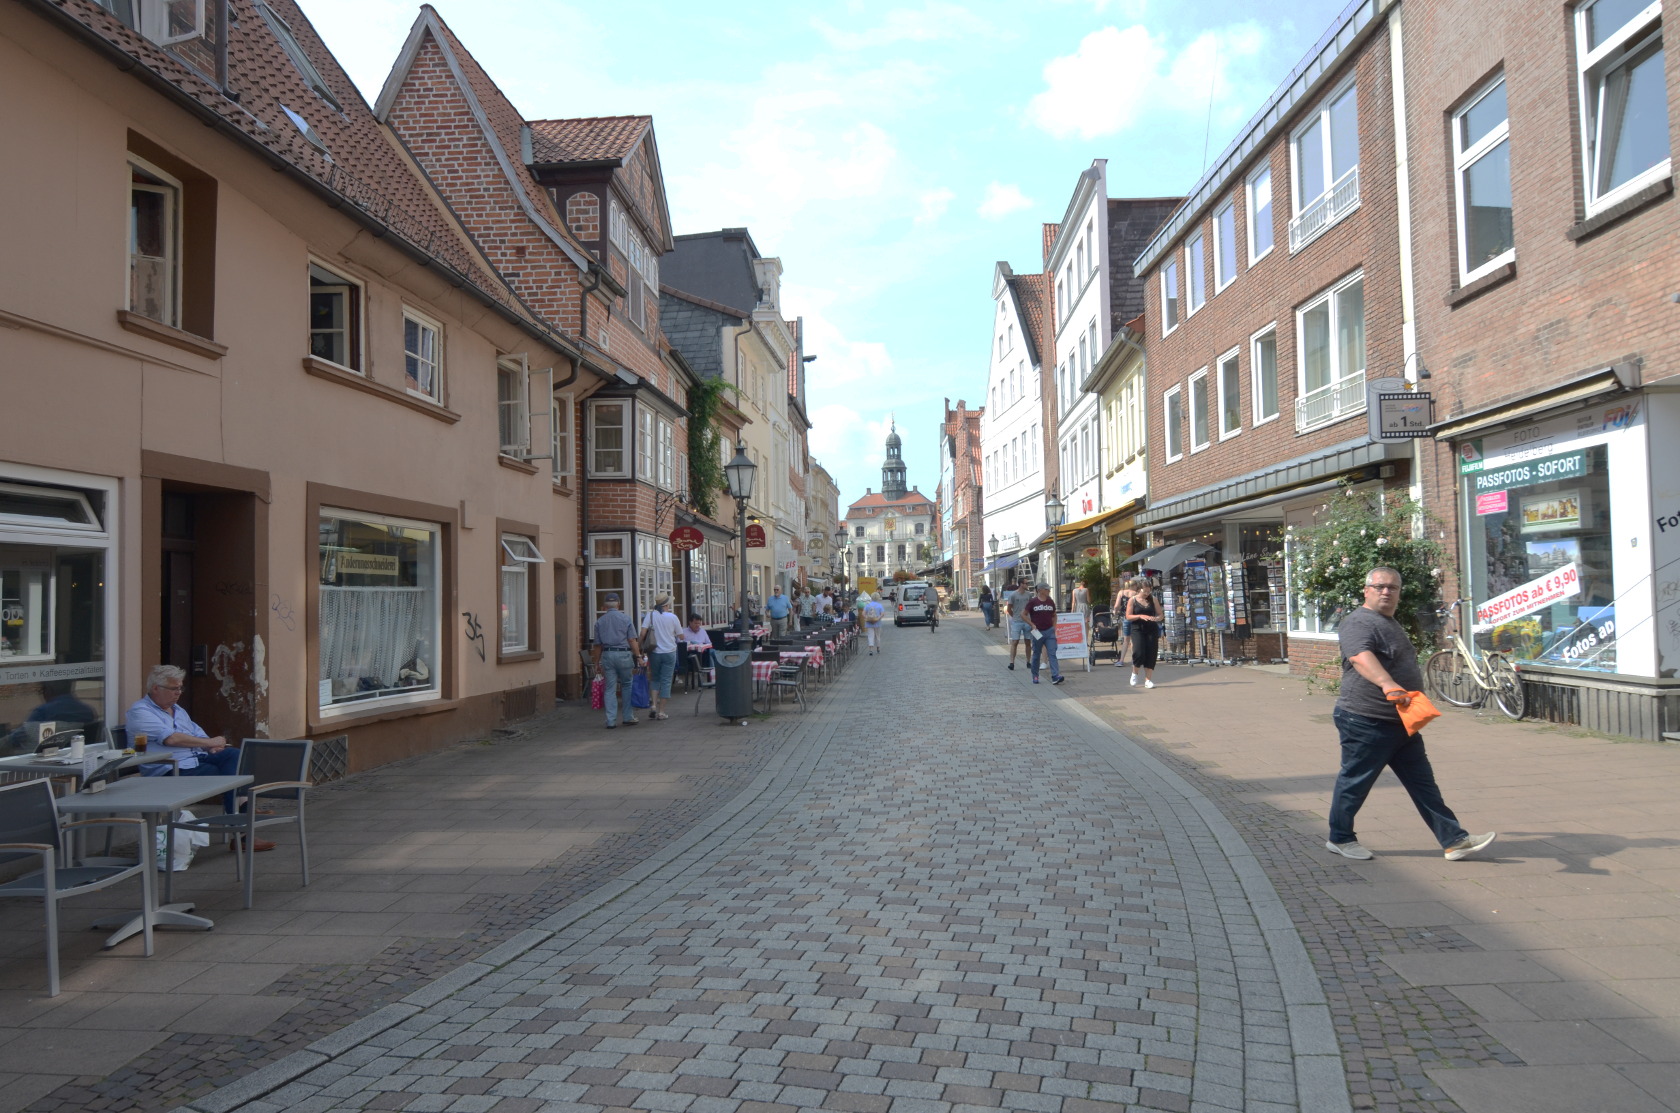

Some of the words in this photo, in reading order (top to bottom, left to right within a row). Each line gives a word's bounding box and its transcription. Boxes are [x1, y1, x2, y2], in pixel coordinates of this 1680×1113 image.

[1401, 415, 1407, 427] 1
[1513, 426, 1541, 443] FOTO
[1461, 461, 1484, 473] FUJIFILM
[1476, 467, 1530, 489] PASSFOTOS
[1537, 456, 1581, 477] SOFORT
[785, 561, 796, 569] EIS
[1477, 590, 1529, 622] PASSFOTOS
[1531, 585, 1544, 600] ab
[1546, 580, 1553, 592] €
[1554, 569, 1577, 589] 9,90
[1512, 606, 1526, 616] ZUM
[1526, 590, 1565, 610] MITNEHMEN
[1562, 633, 1597, 663] Fotos
[1599, 620, 1615, 639] ab
[5, 671, 29, 680] Torten
[40, 665, 104, 678] Kaffeespezialitäten
